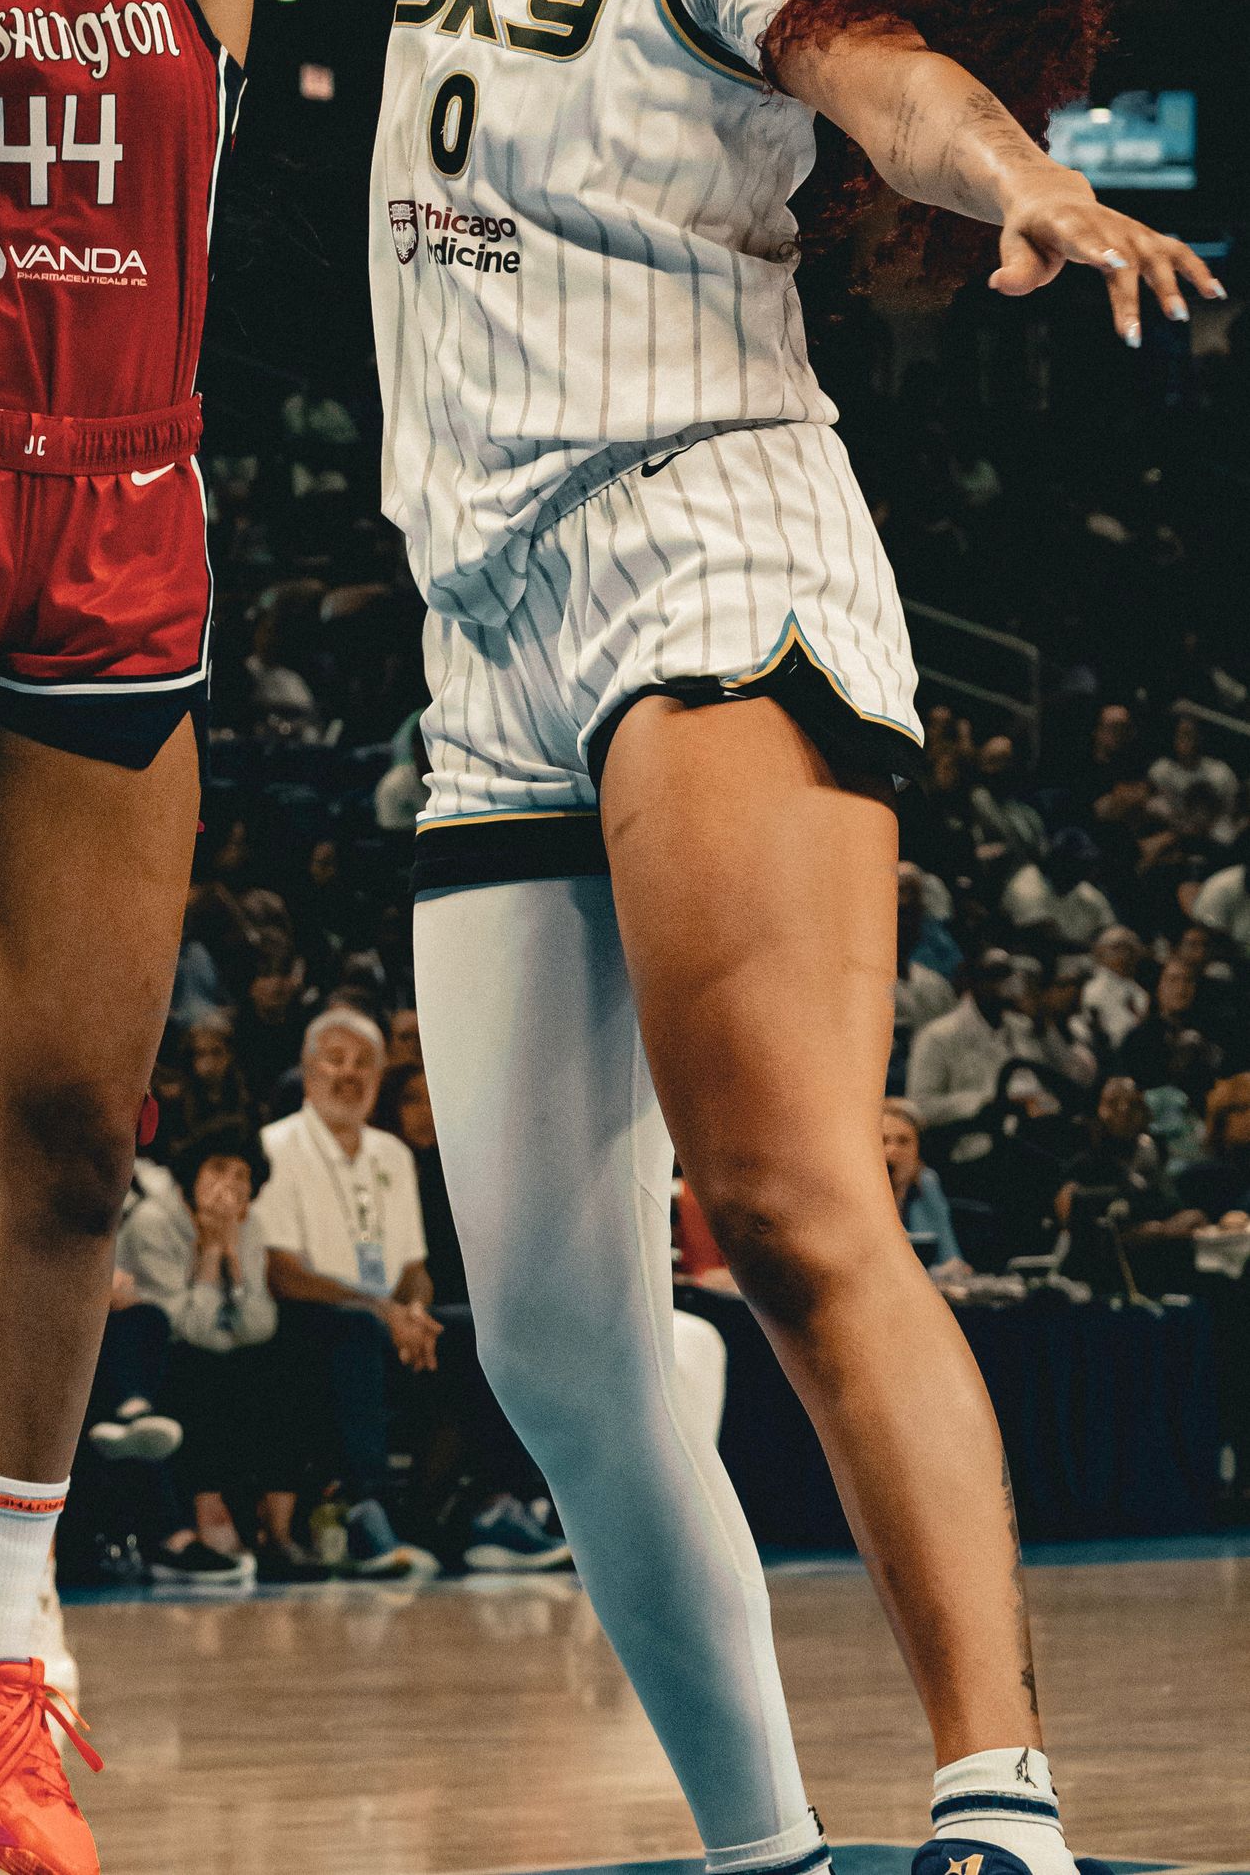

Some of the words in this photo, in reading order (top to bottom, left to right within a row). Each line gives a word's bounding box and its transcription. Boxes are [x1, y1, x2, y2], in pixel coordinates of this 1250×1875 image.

[427, 70, 479, 181] 0
[418, 203, 517, 243] hicago
[9, 244, 147, 275] VANDA
[17, 272, 128, 286] PHARMACEUTICALS
[24, 435, 47, 456] JC
